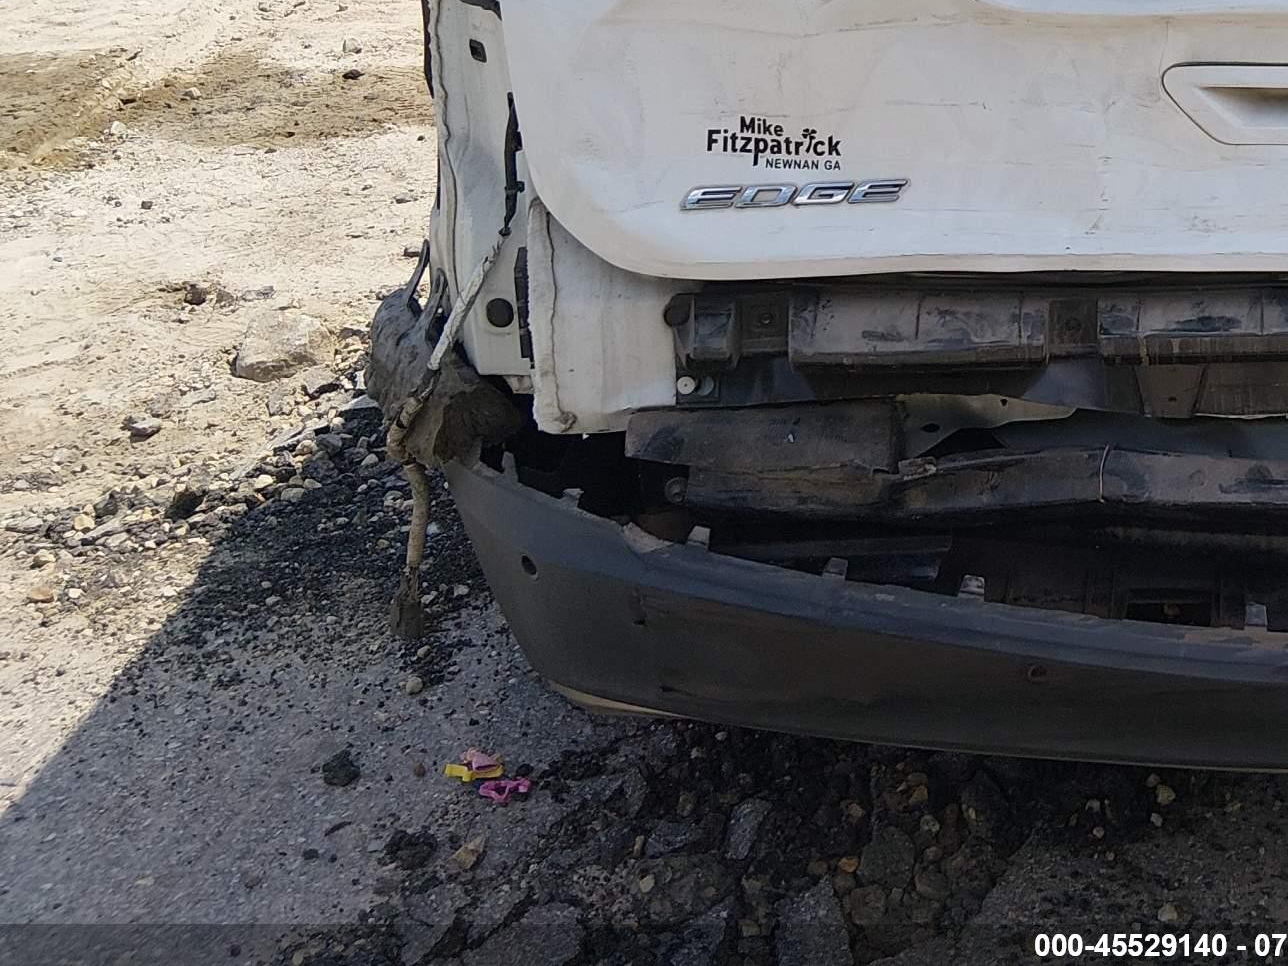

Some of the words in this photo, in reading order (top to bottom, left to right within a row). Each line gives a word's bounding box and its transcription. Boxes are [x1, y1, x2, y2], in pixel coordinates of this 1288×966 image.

[740, 116, 784, 137] Mike
[707, 128, 842, 166] Fitzpatrick
[765, 158, 819, 171] NEWNAN
[823, 159, 841, 171] GA
[680, 178, 910, 211] EDGE
